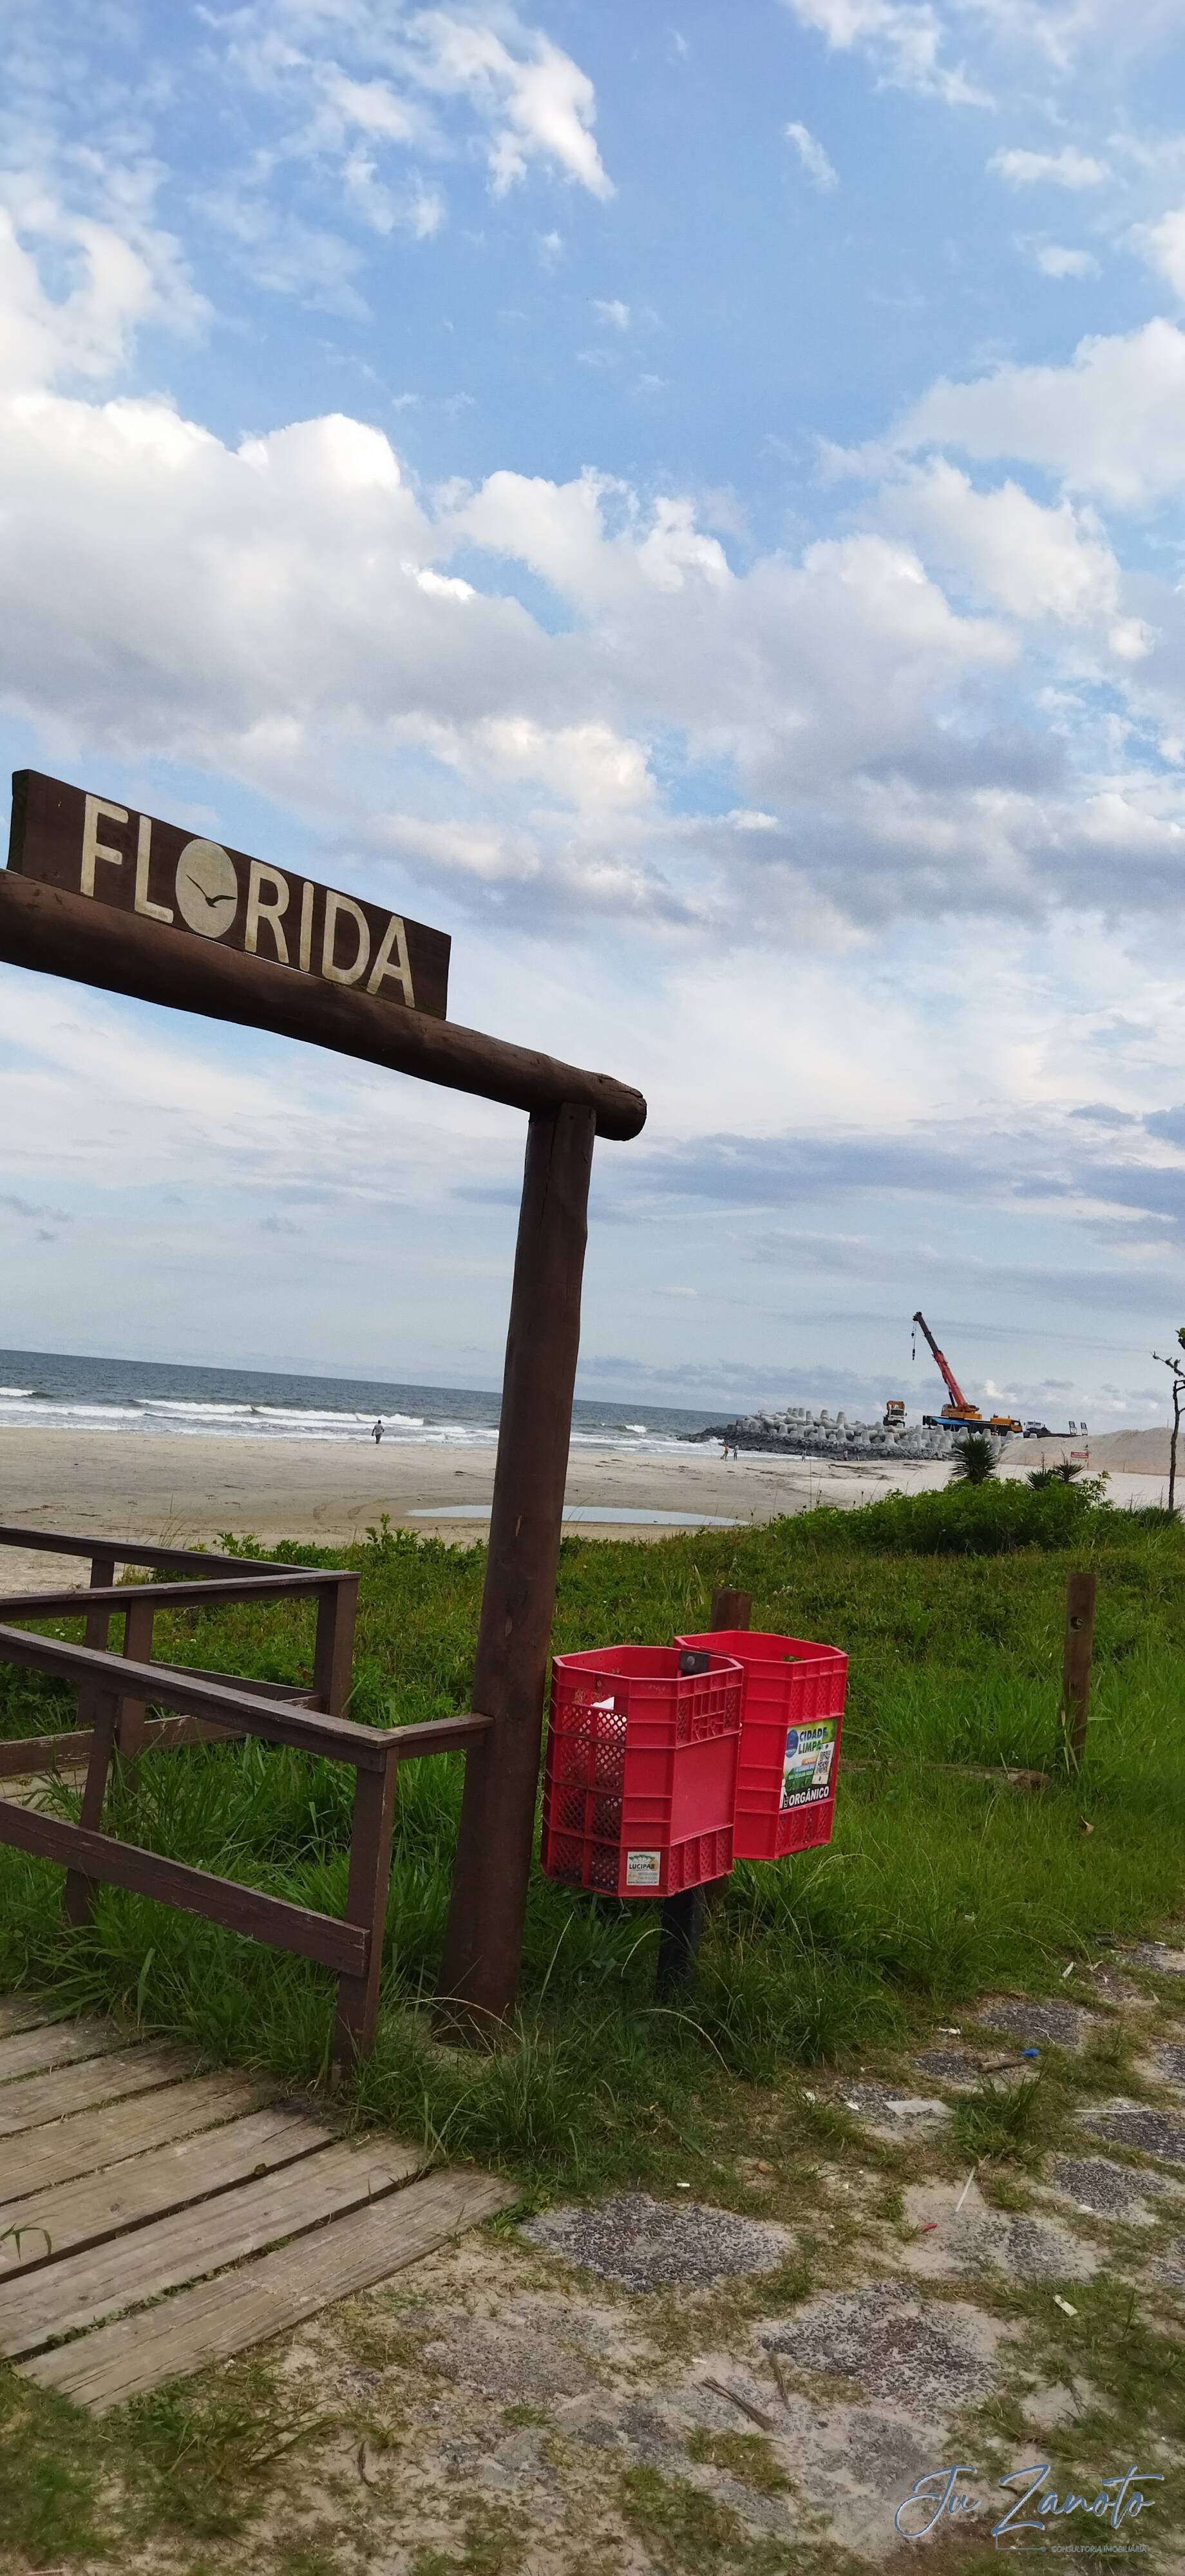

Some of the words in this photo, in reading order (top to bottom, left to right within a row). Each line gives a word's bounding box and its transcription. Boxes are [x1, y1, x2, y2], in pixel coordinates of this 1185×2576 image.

[81, 794, 415, 1008] FLORIDA
[800, 1727, 827, 1742] CIDADE
[798, 1740, 821, 1754] LIMPA
[789, 1786, 830, 1806] ORGÂNICO
